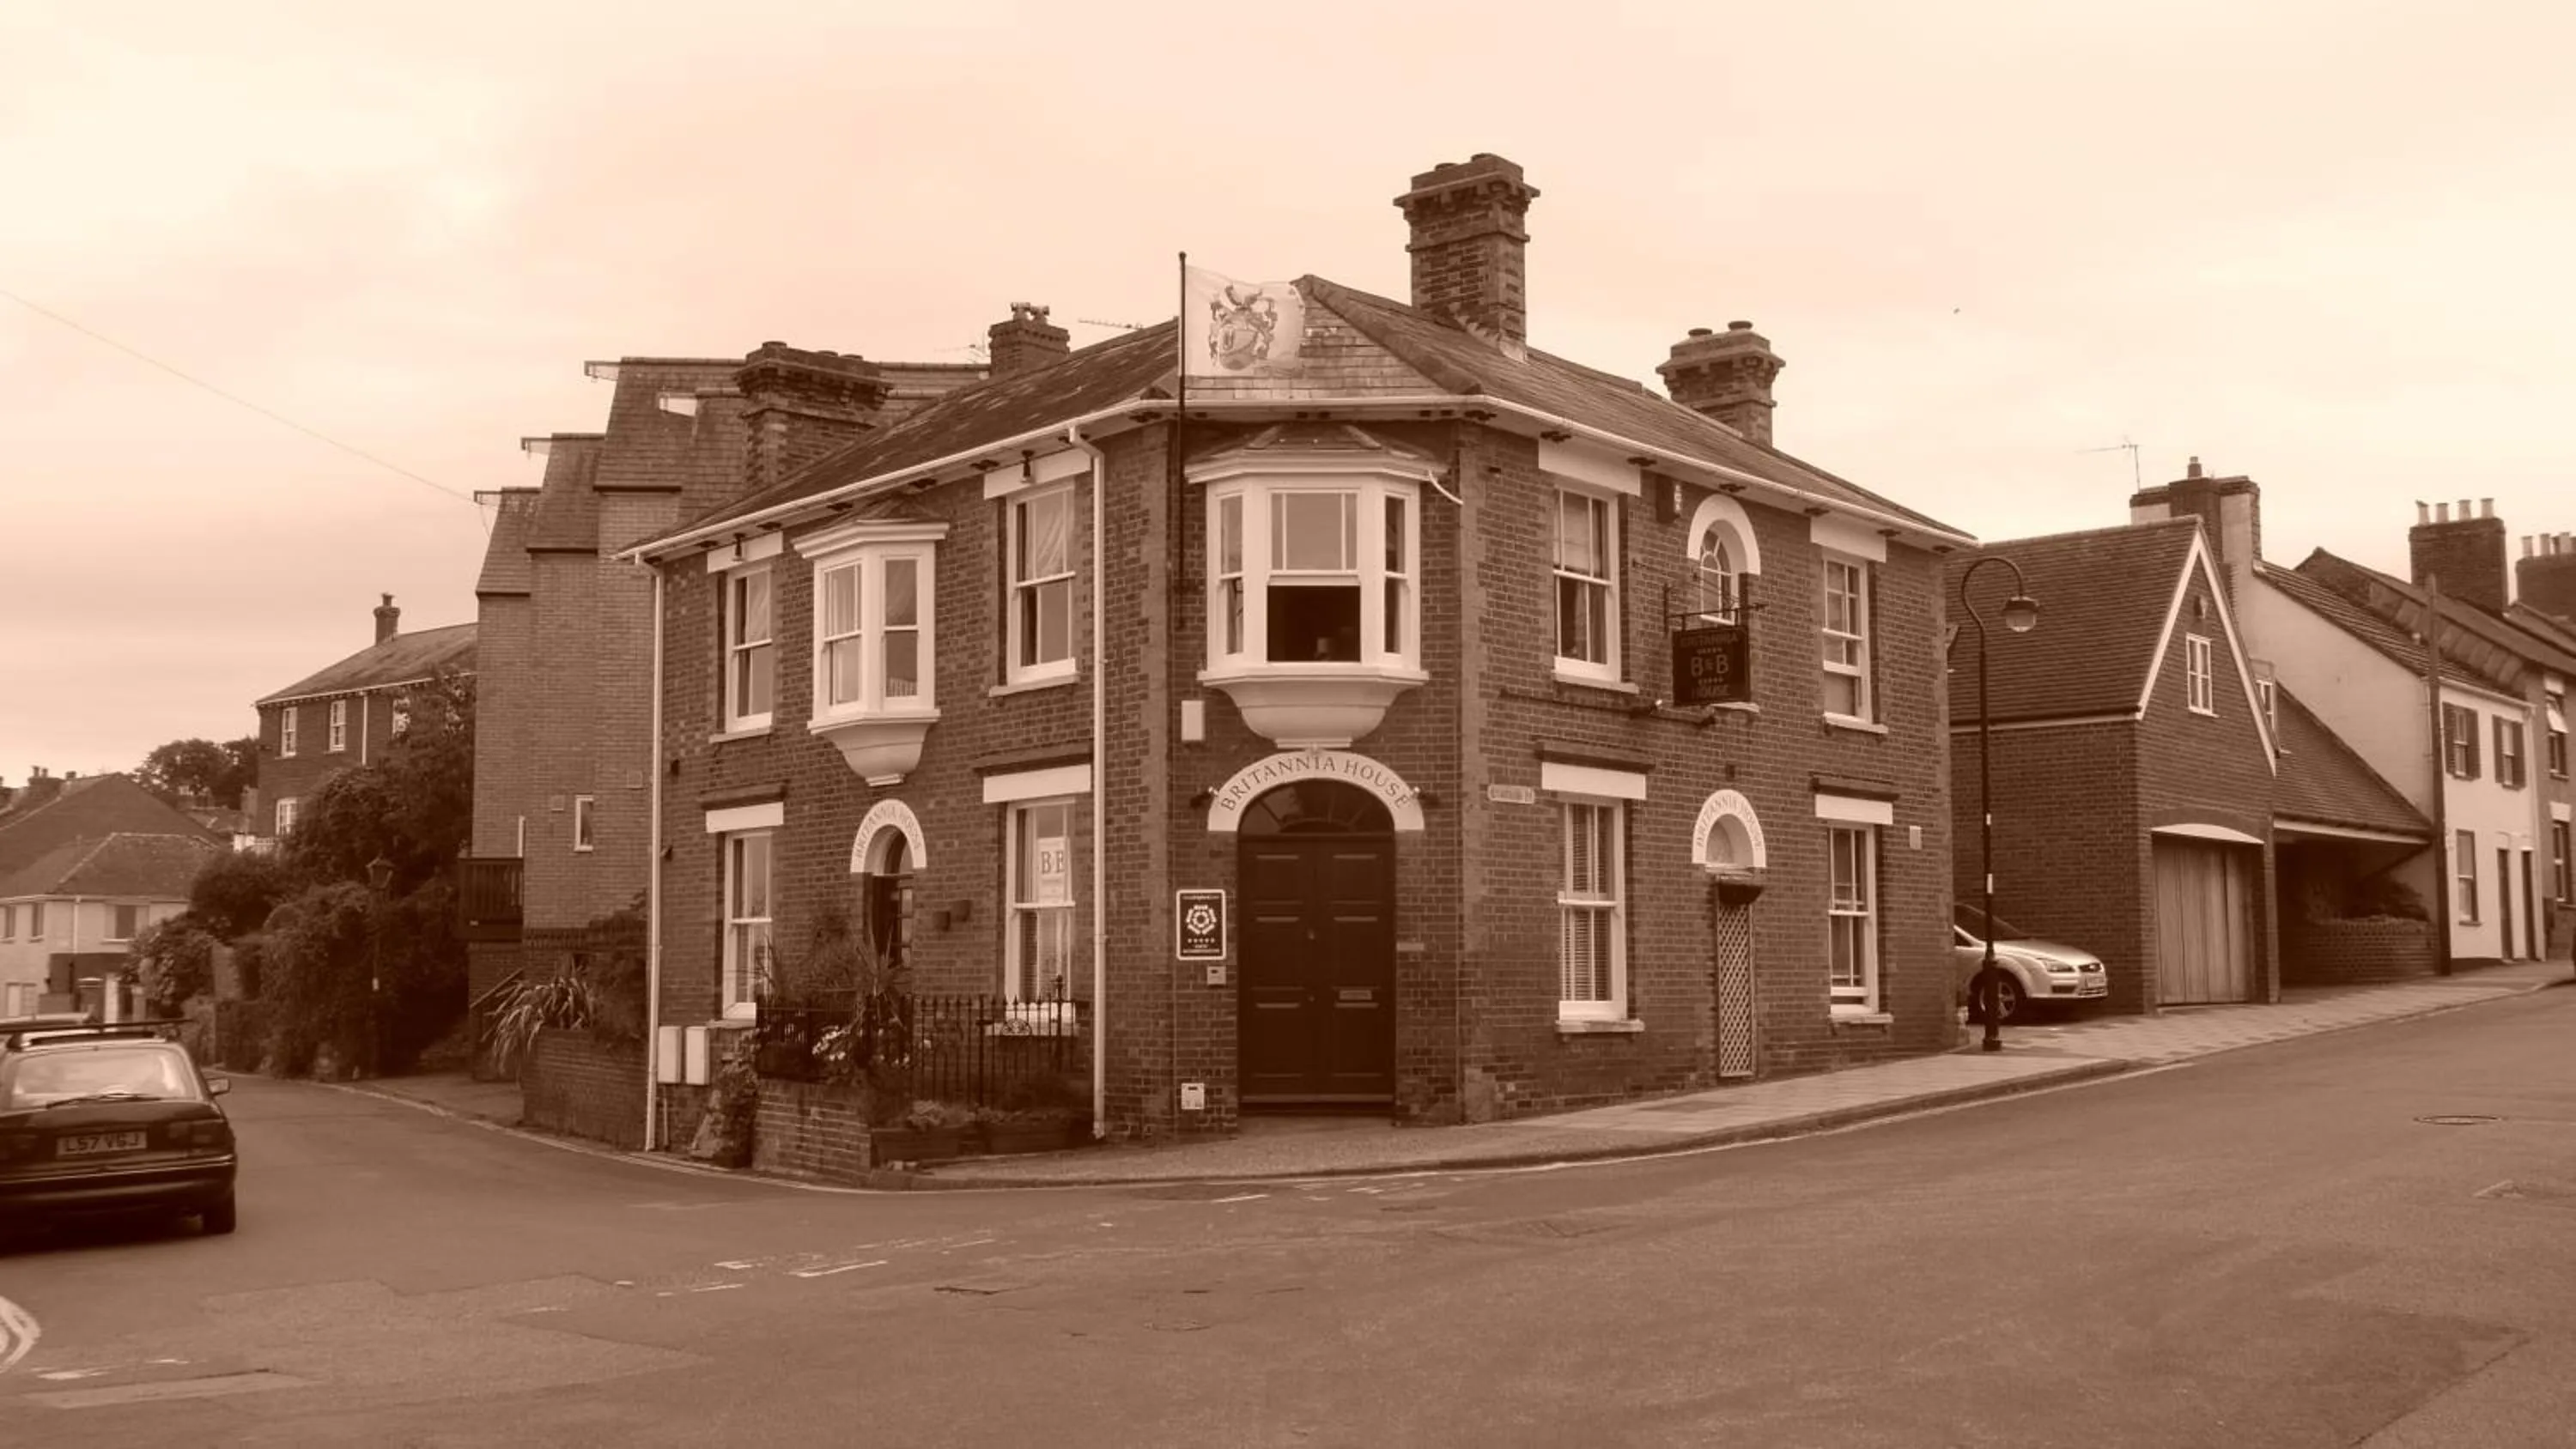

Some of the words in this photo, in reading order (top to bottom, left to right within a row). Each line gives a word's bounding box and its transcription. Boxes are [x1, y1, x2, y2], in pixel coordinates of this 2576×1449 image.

[1680, 633, 1738, 648] BRITANNIA
[1691, 683, 1732, 698] HOUSE
[1220, 755, 1336, 812] BRITANNIA
[1344, 758, 1411, 809] HOUSE
